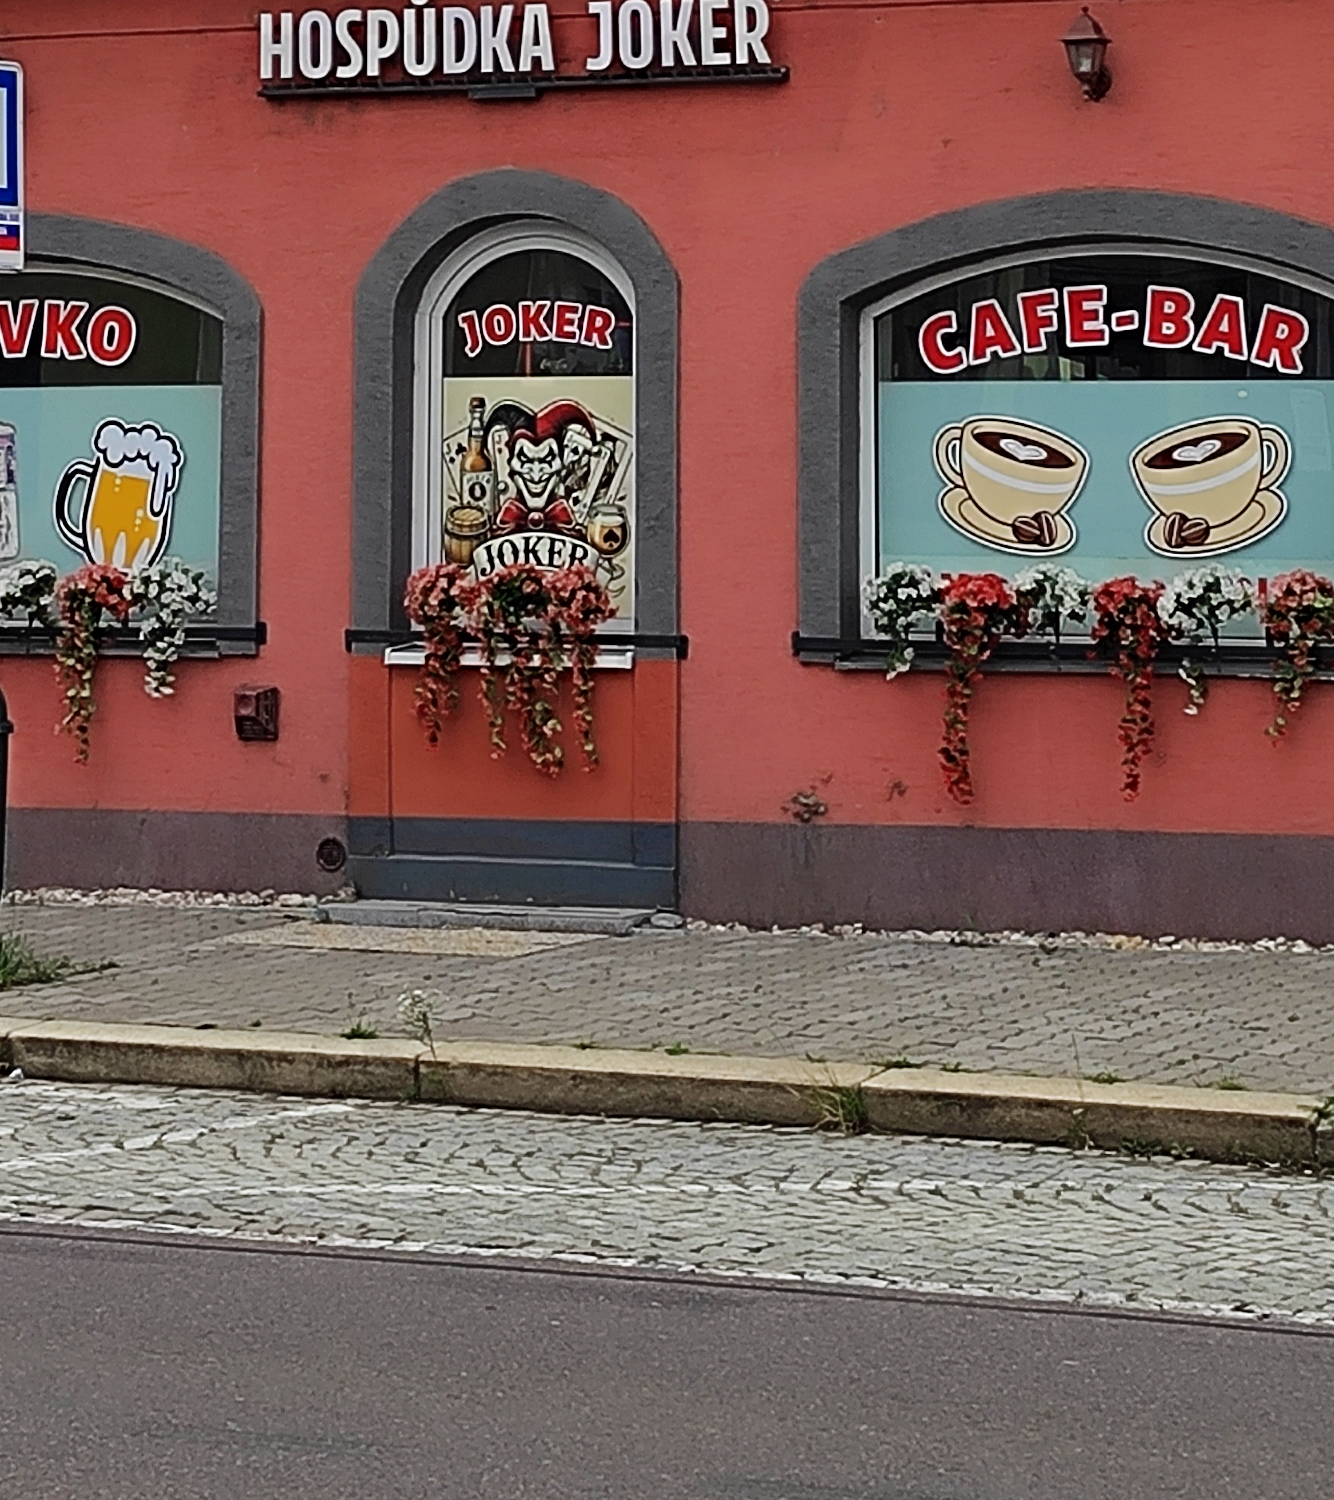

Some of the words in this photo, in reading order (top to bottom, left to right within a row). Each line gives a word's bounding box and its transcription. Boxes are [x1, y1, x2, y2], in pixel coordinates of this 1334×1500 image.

[459, 300, 615, 357] JOKER
[919, 285, 1309, 374] CAFE-BAR
[480, 536, 588, 577] JOKER
